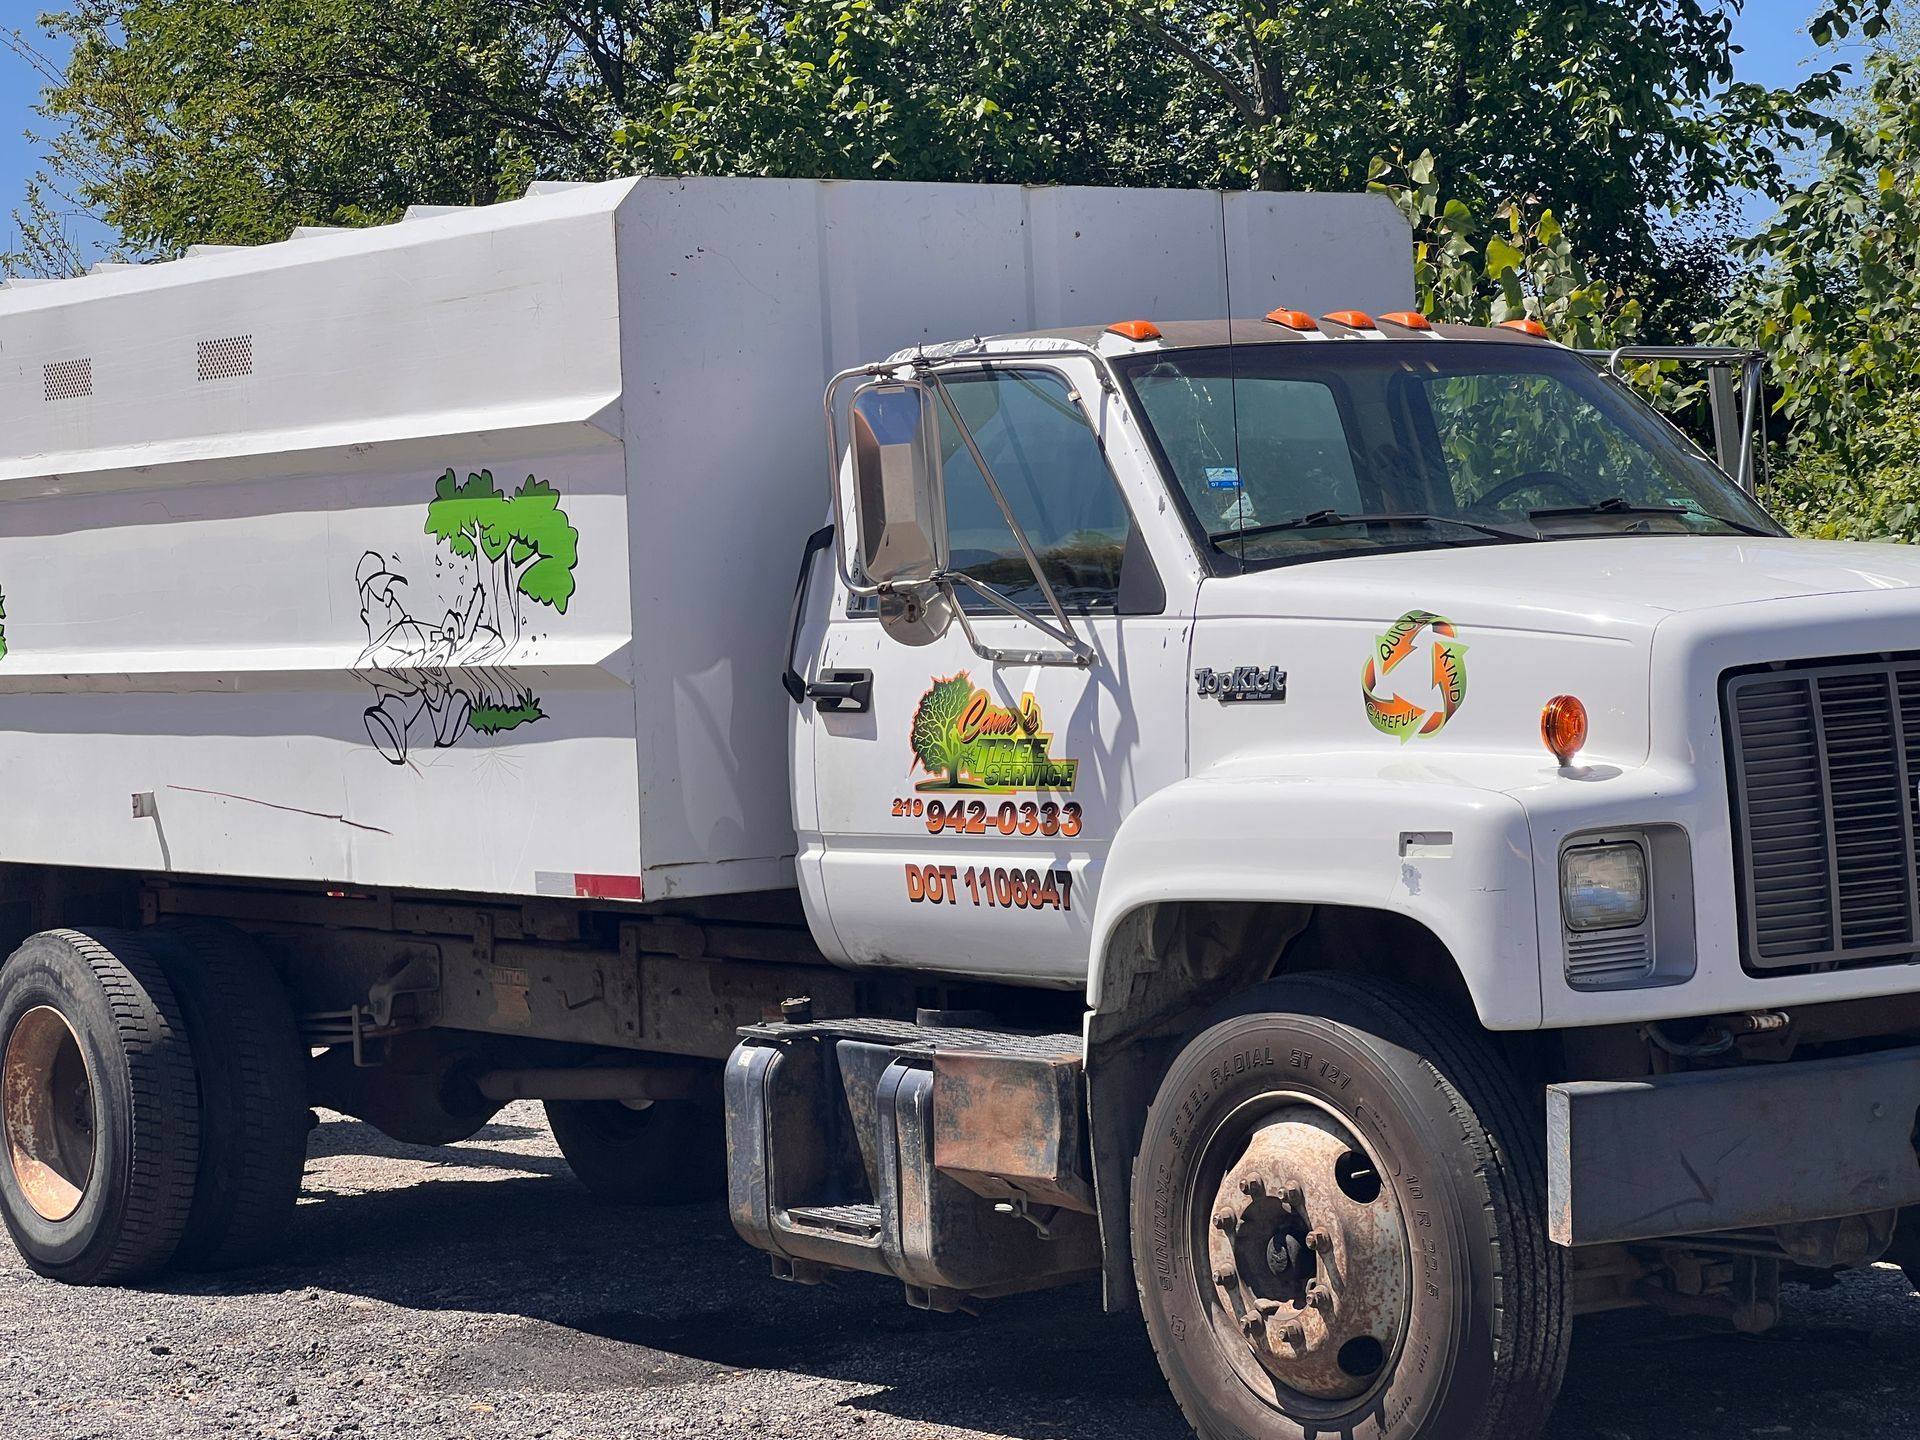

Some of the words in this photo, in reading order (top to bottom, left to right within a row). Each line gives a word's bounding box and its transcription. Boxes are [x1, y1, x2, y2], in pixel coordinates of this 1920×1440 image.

[1380, 615, 1423, 661] QUICK
[1195, 665, 1287, 700] TopKick
[1440, 647, 1461, 702] KIND
[1366, 703, 1418, 728] CAREFUL
[974, 738, 1048, 774] TREE
[984, 764, 1076, 787] SERVICE
[892, 798, 923, 817] 219
[925, 800, 1083, 837] 942-0333
[905, 863, 957, 905] DOT
[964, 866, 1073, 911] 1106847
[1153, 1164, 1174, 1292] SUMITOMO
[1210, 1047, 1274, 1090] RADIAL
[1290, 1048, 1313, 1070] ST
